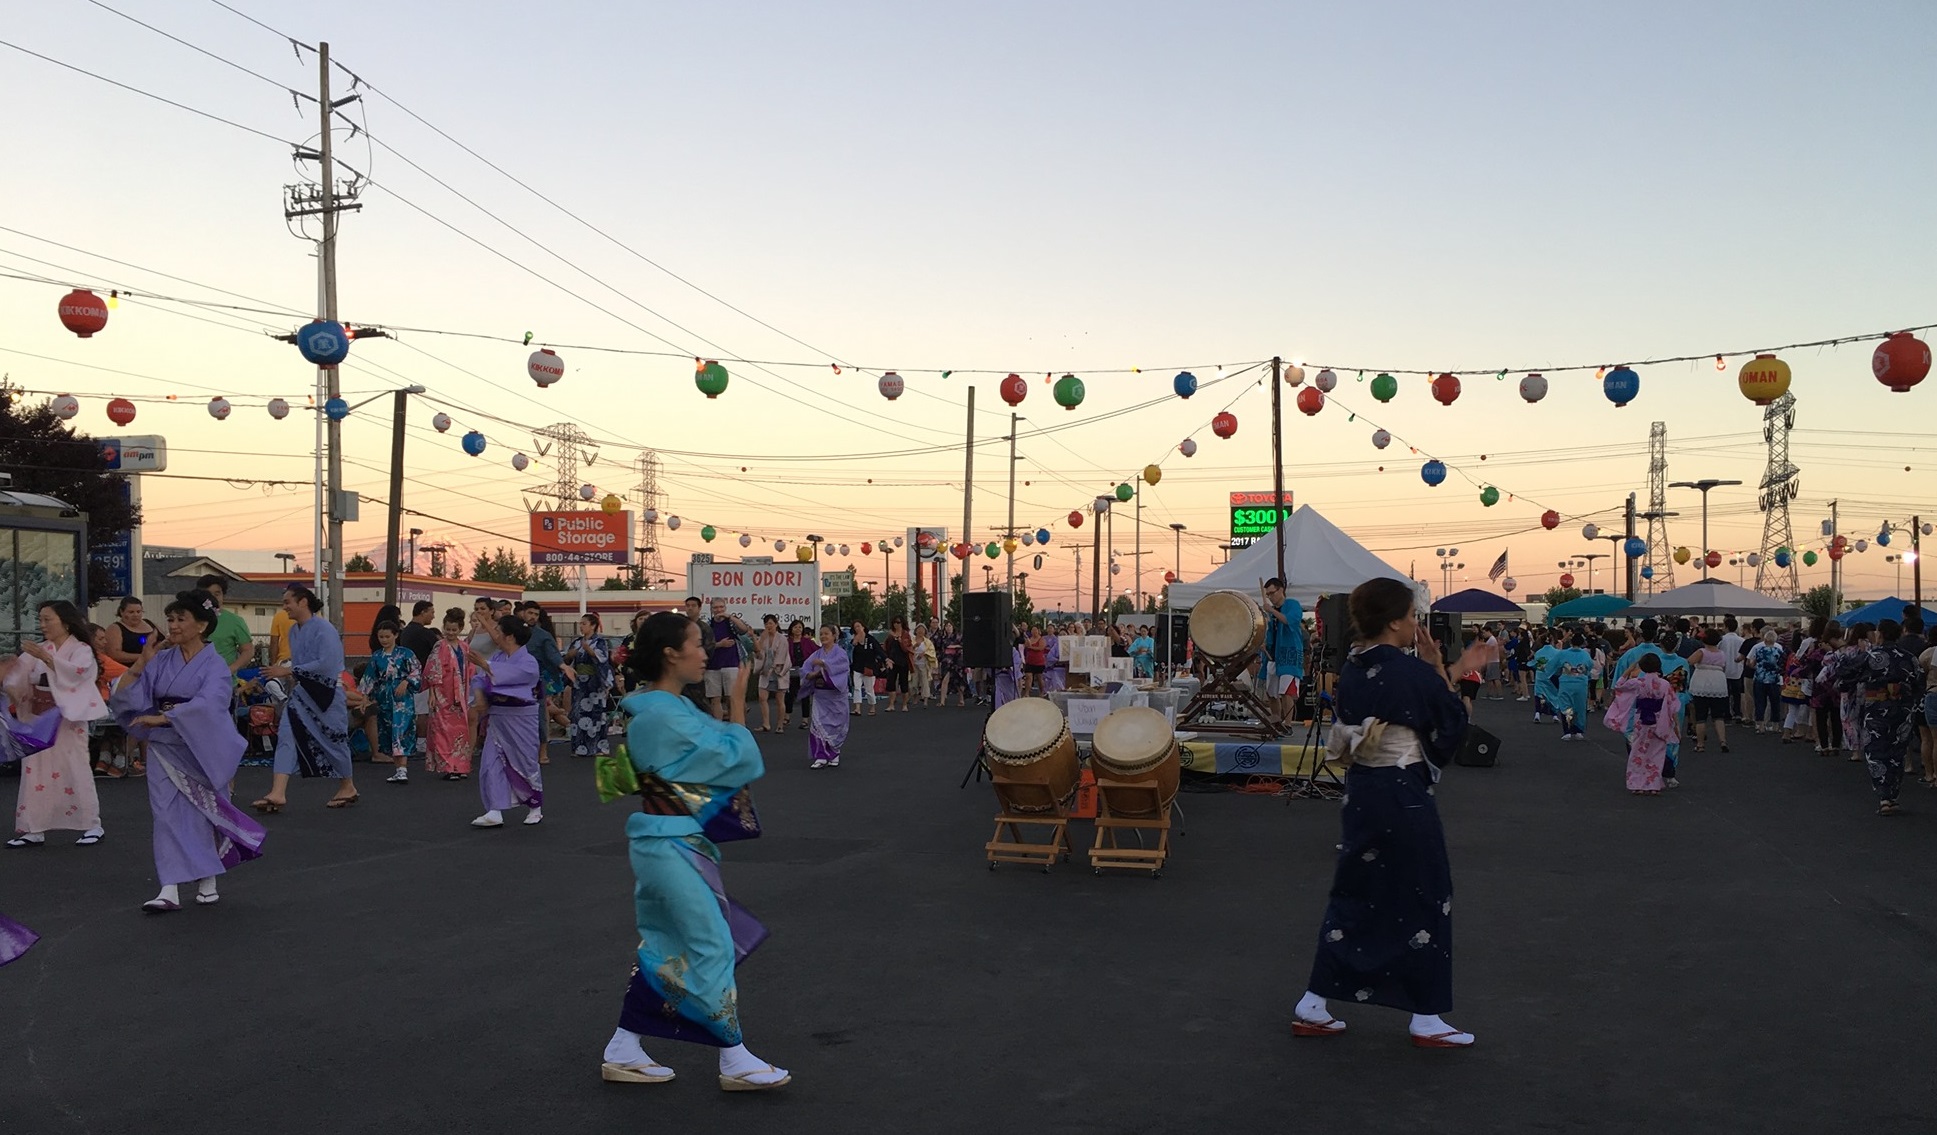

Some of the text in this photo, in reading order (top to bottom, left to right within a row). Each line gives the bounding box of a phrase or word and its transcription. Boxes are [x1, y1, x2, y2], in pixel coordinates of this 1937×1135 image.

[123, 450, 155, 461] ampm
[1247, 493, 1292, 504] TOYOA
[558, 517, 604, 530] Public
[558, 531, 616, 547] Storage
[1231, 537, 1250, 546] 2017
[692, 554, 710, 563] 3625
[712, 571, 802, 587] BON ODORI
[409, 592, 431, 602] Parking
[751, 593, 773, 605] Folk
[779, 593, 810, 605] Dance
